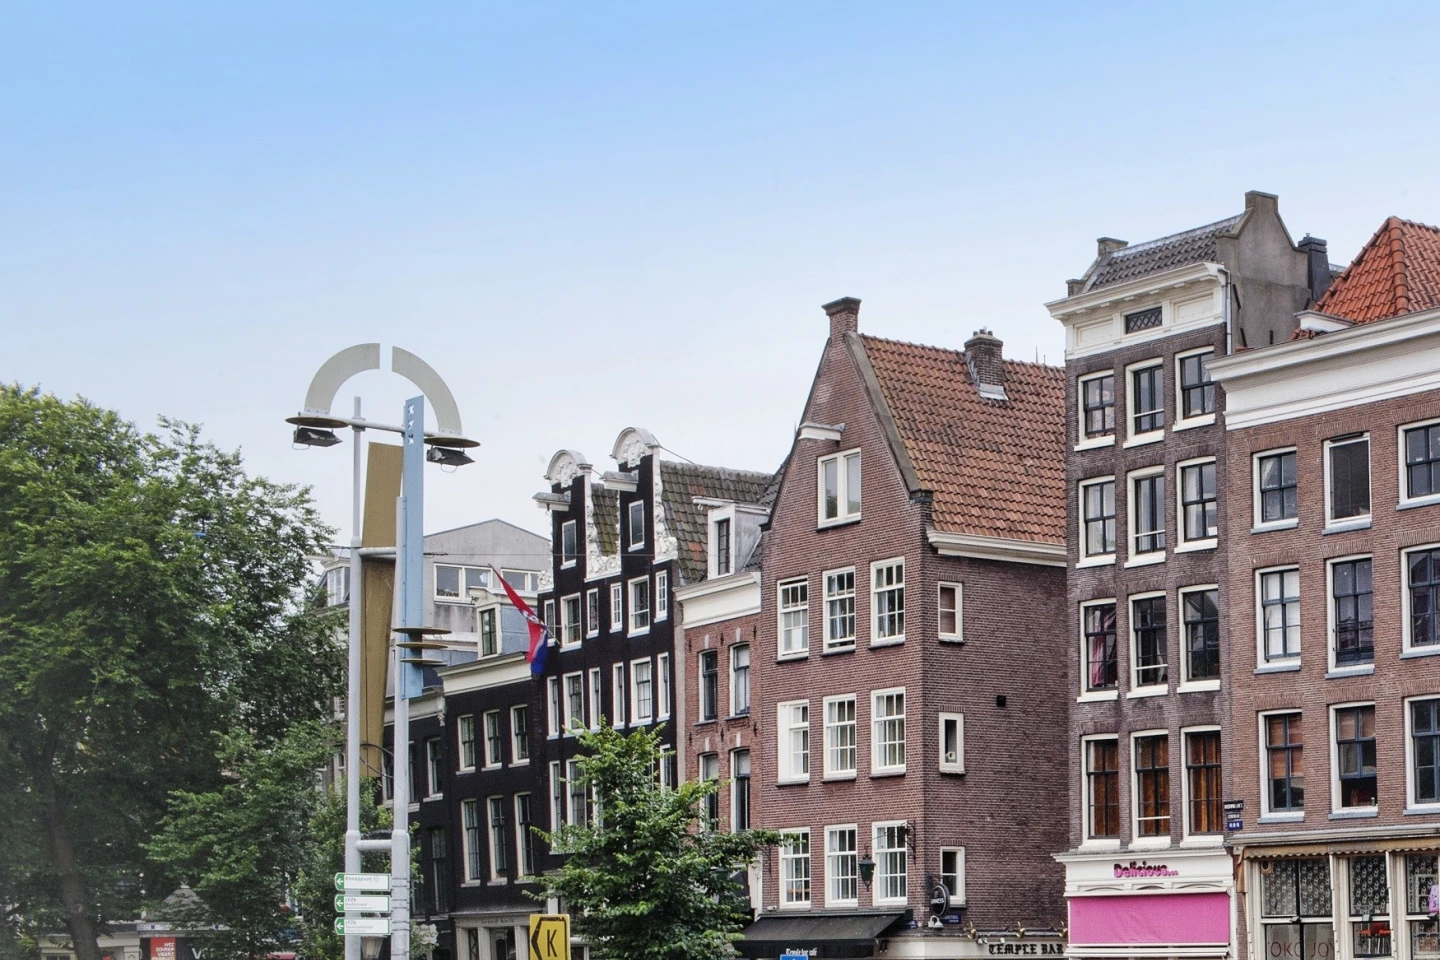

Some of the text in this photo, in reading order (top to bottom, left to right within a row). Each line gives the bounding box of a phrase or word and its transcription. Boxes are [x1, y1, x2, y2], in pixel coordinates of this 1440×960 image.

[546, 929, 558, 957] K
[988, 943, 1064, 955] TEMPLE BAR
